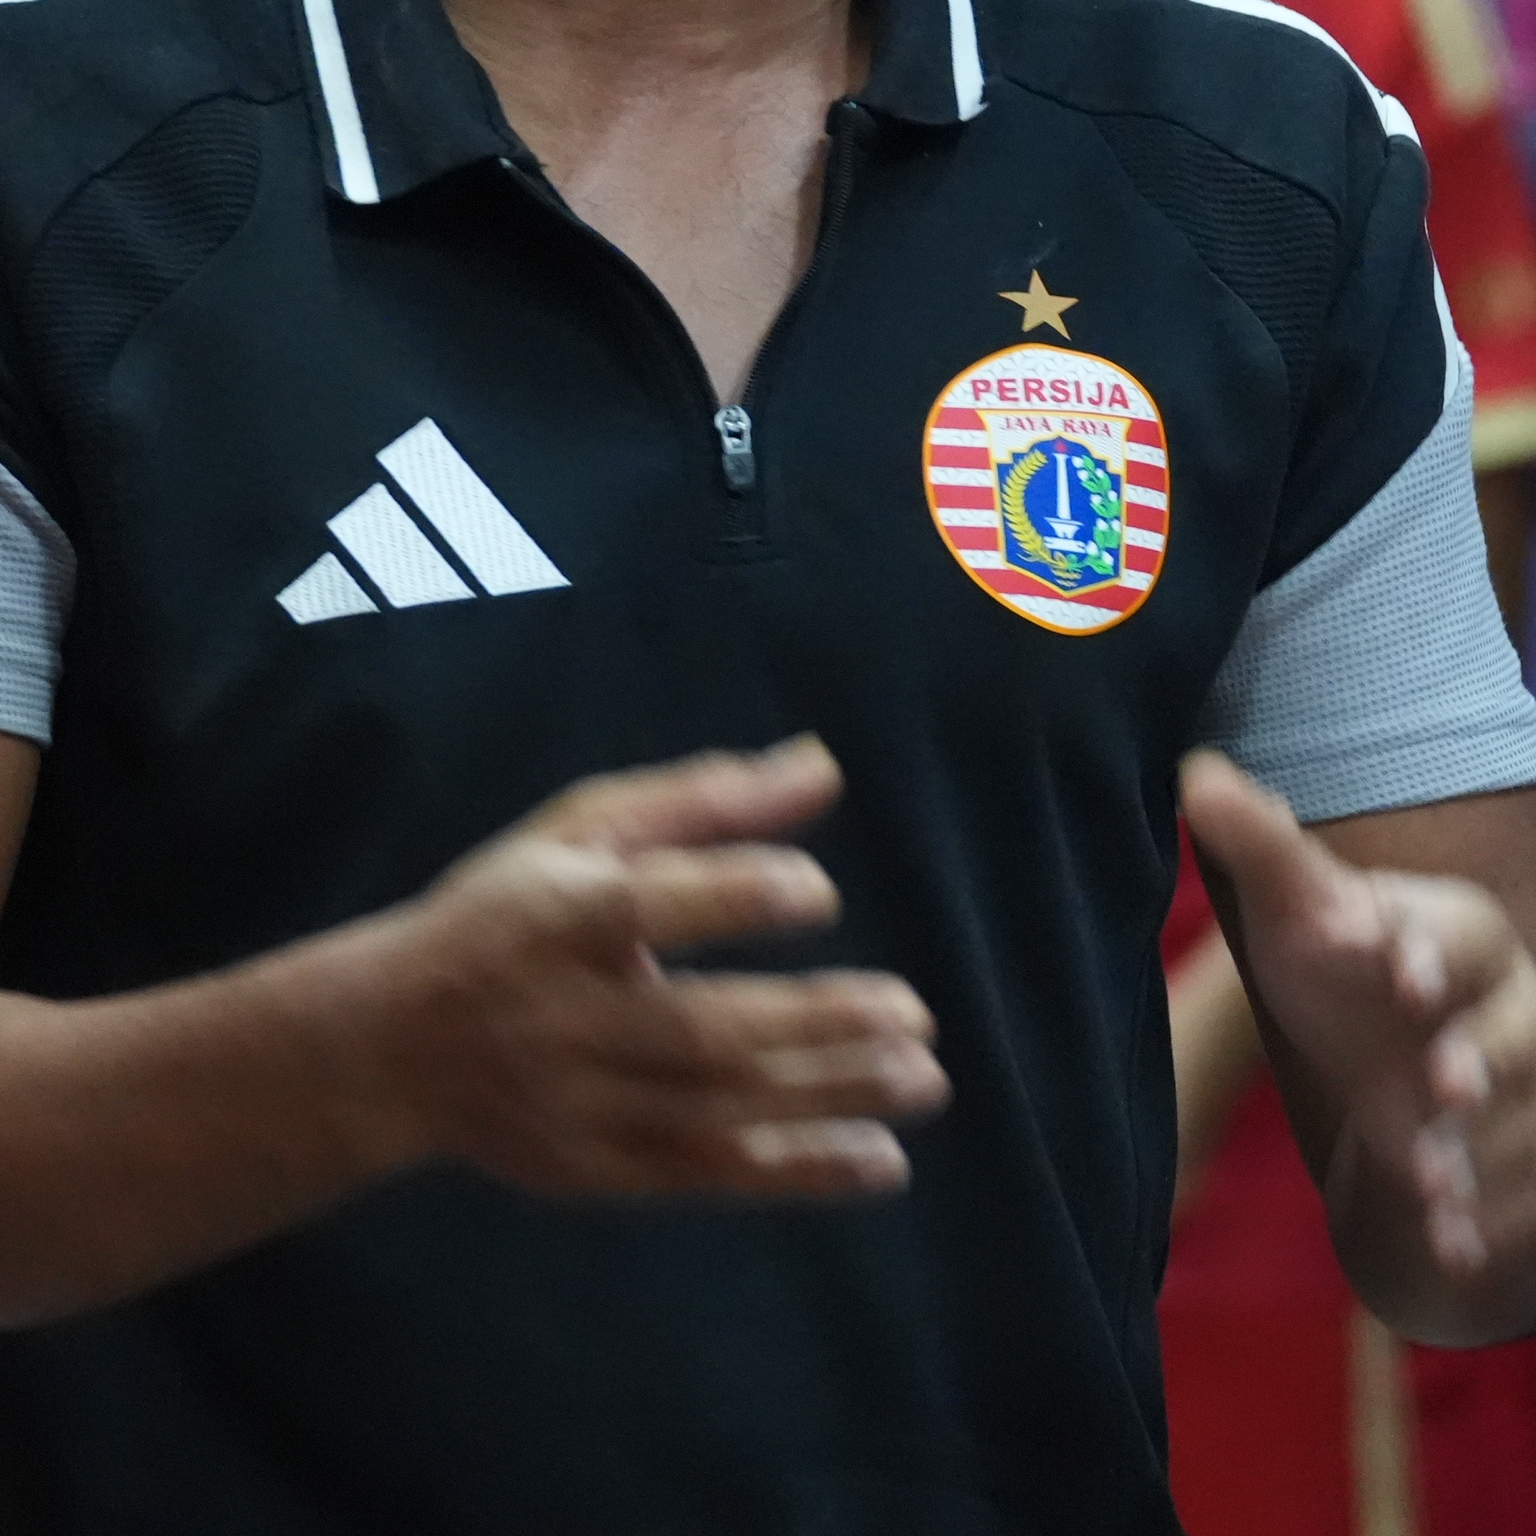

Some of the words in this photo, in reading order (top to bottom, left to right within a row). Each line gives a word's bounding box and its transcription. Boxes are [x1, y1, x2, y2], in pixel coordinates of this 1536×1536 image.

[971, 378, 1130, 410] PERSIJA
[1001, 416, 1053, 432] JAYA
[1063, 419, 1114, 438] RAYA
